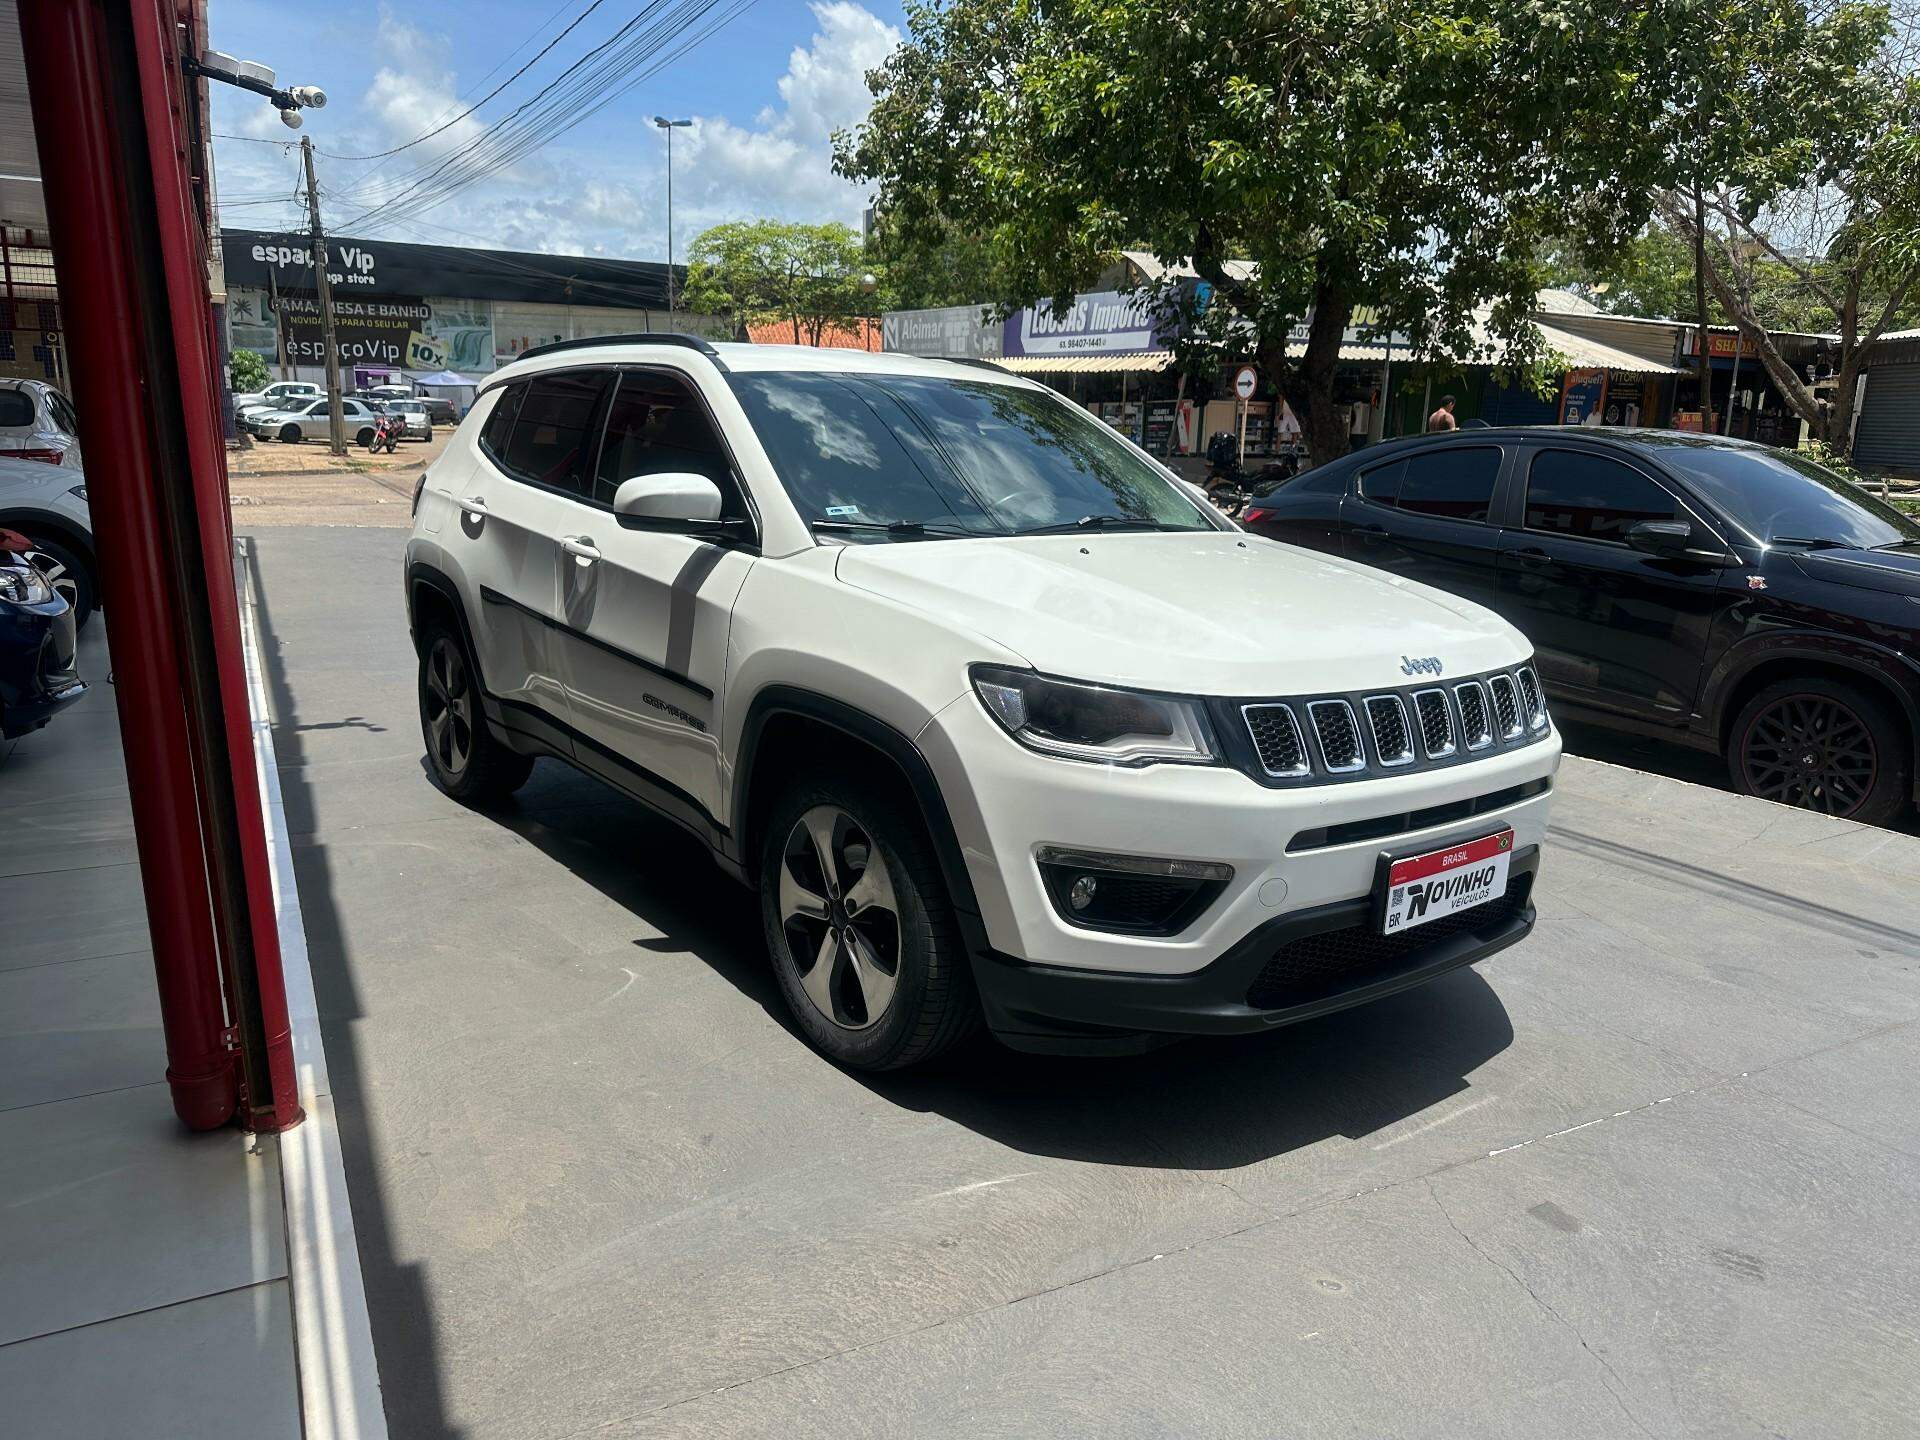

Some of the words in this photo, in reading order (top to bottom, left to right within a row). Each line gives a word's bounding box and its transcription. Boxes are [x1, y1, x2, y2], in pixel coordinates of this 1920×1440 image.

[252, 245, 328, 268] espaç
[340, 246, 375, 274] Vip
[347, 273, 376, 285] store
[271, 299, 319, 314] AMA,
[367, 304, 376, 315] E
[379, 304, 429, 318] BANHO
[342, 318, 365, 327] PARA
[375, 320, 391, 328] SEU
[392, 321, 409, 329] LAR
[902, 320, 943, 340] Alcimar
[1400, 655, 1442, 676] Jeep
[1442, 851, 1468, 866] BRASIL
[1406, 865, 1496, 921] NOVINHO
[1389, 912, 1401, 928] BR
